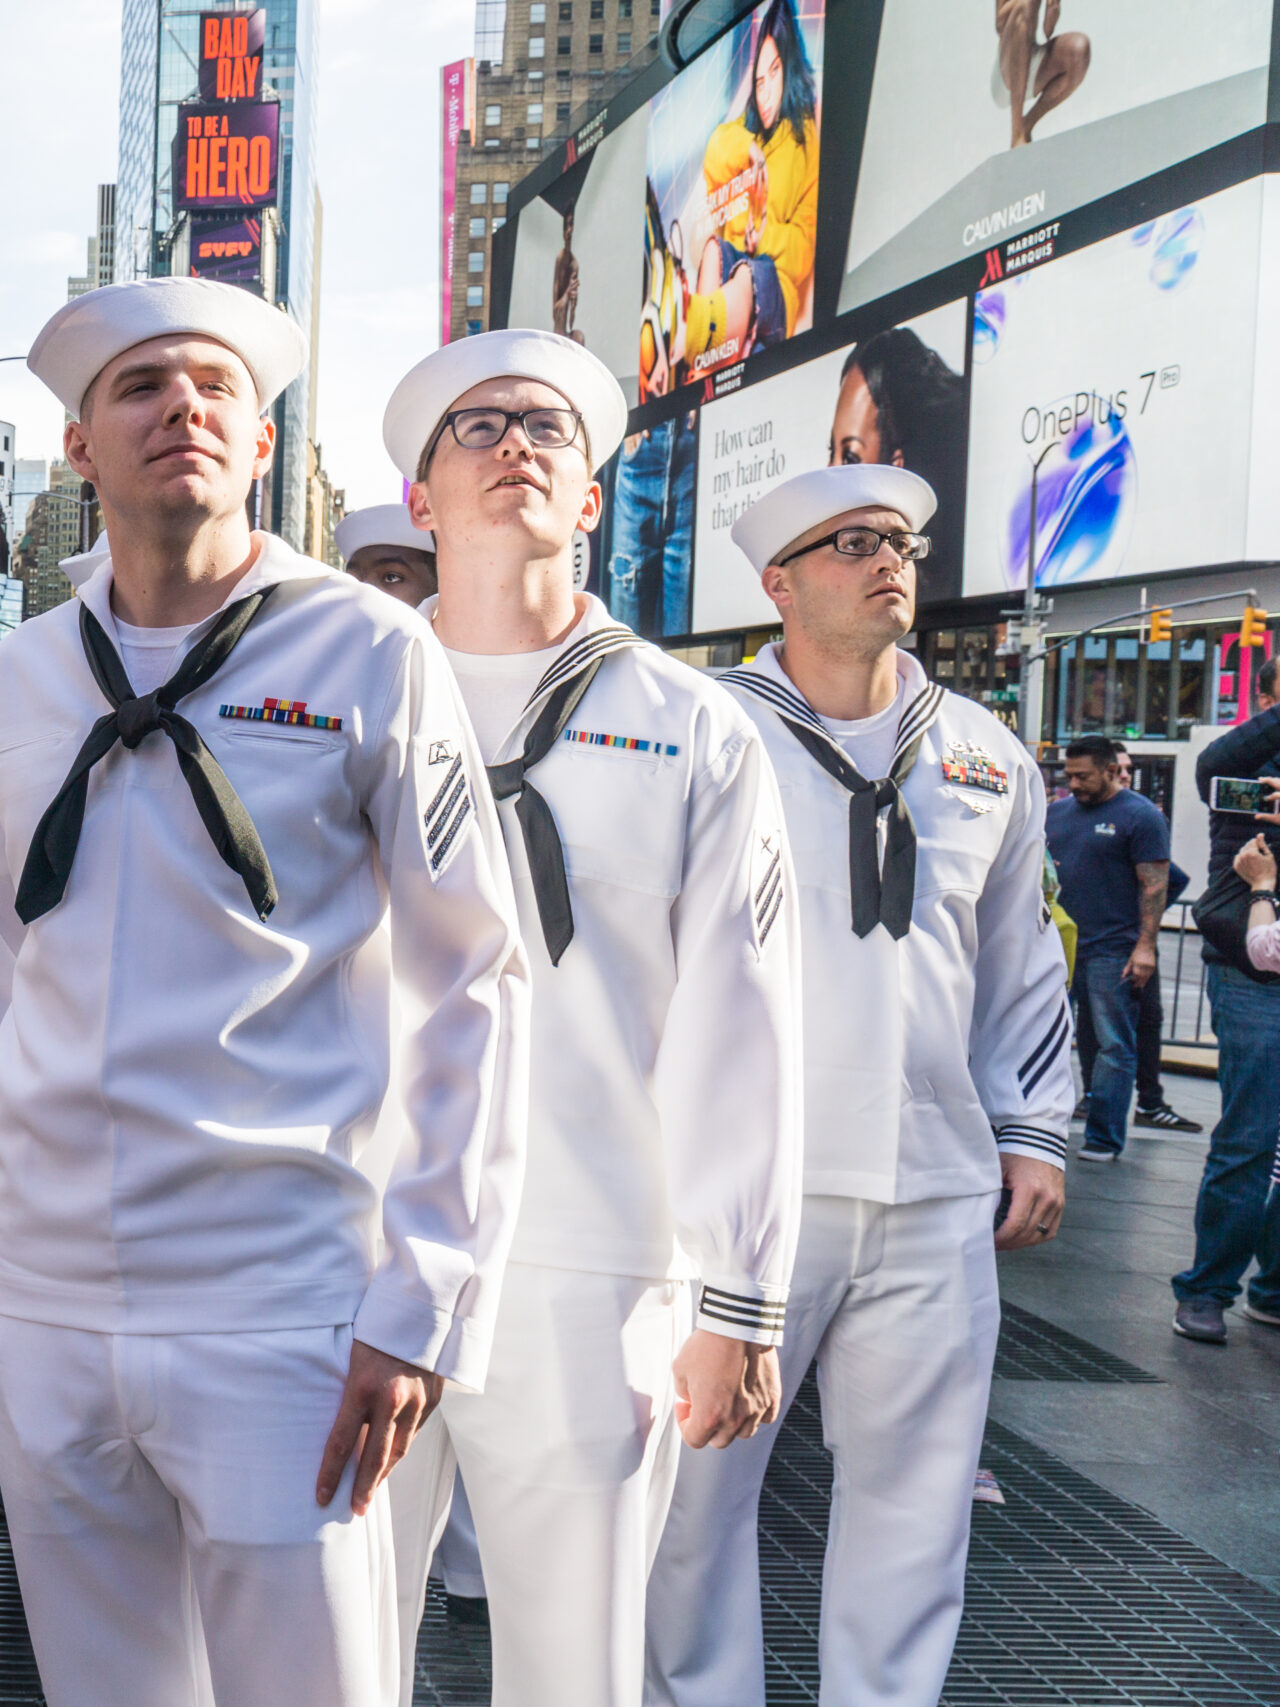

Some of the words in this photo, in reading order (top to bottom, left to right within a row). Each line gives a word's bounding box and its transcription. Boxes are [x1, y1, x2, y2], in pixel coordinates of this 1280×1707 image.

[204, 17, 249, 60] BAD
[216, 56, 260, 99] DAY
[186, 117, 202, 137] TO
[204, 116, 219, 137] BE
[220, 115, 229, 136] A
[578, 108, 608, 141] MARRIOTT
[186, 136, 270, 204] HERO
[963, 207, 1007, 247] CALVIN
[1008, 190, 1045, 226] KLEIN
[199, 241, 252, 258] SYFY
[1006, 222, 1060, 256] MARRIOTT
[1006, 242, 1053, 273] MARQUIS
[694, 348, 719, 371] CALVIN
[719, 336, 739, 360] KLEIN
[715, 362, 745, 383] MARRIOTT
[1022, 389, 1128, 444] OnePlus
[1139, 371, 1156, 415] 7
[1162, 371, 1178, 383] Pro
[714, 429, 747, 459] How
[748, 420, 773, 447] can
[713, 469, 735, 499] my
[736, 454, 765, 487] hair
[765, 448, 786, 478] do
[712, 502, 738, 530] that
